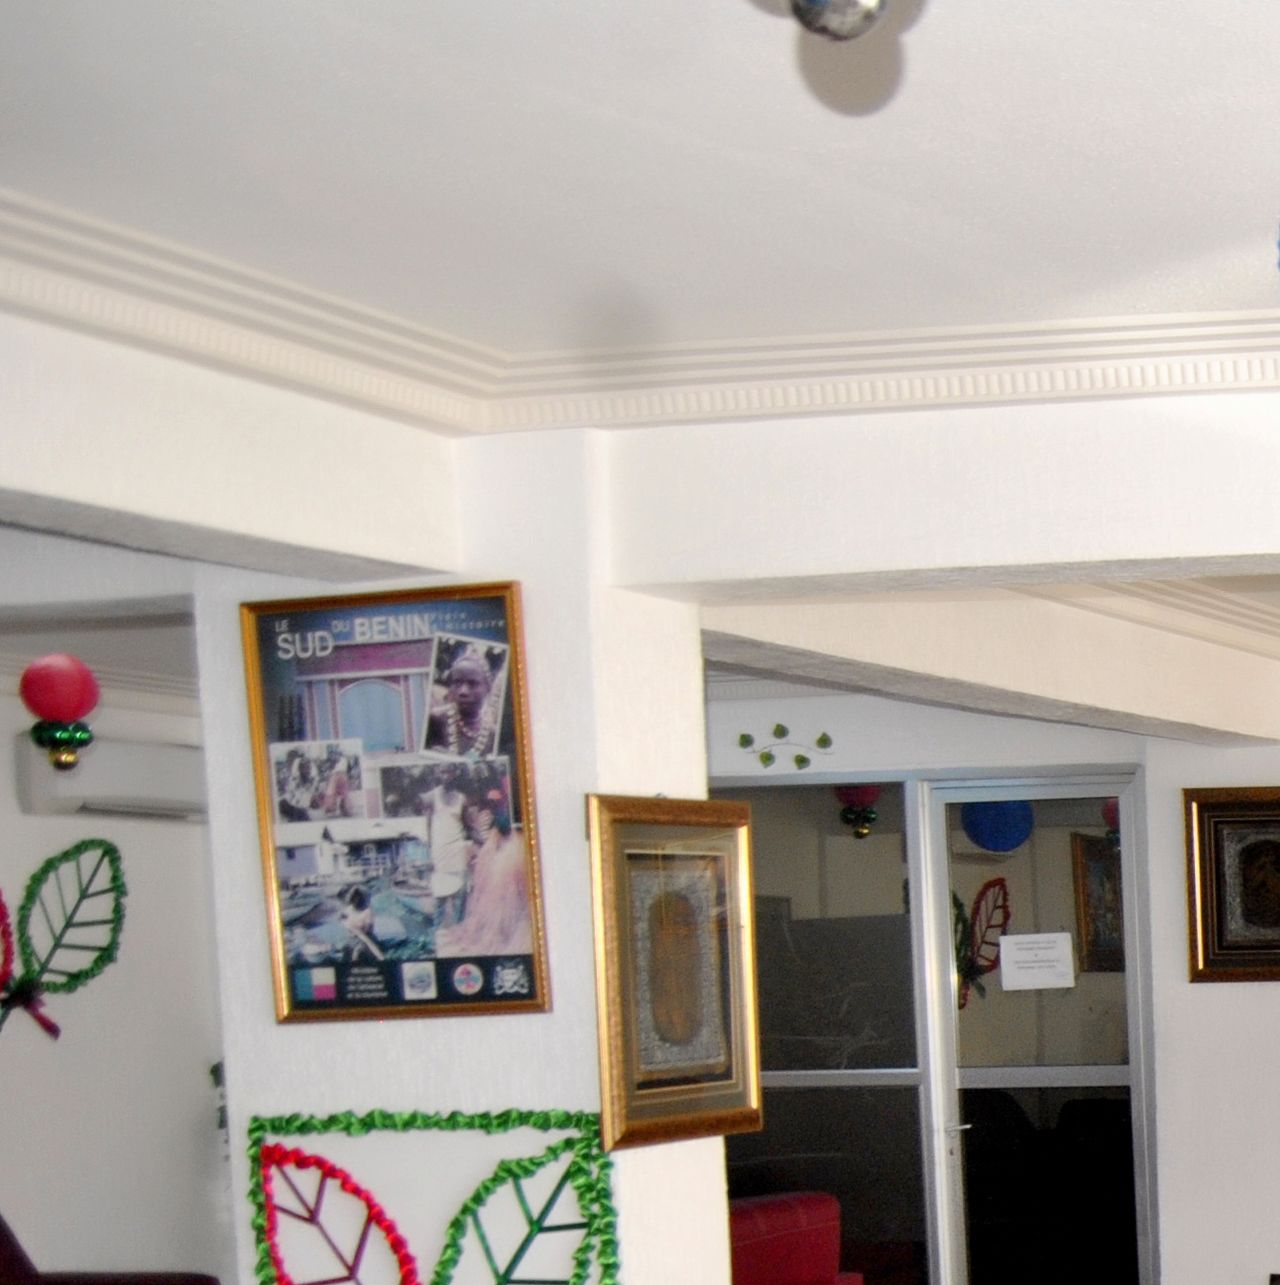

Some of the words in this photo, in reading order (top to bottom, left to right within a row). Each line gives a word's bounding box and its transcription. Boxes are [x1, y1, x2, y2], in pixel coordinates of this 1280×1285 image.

[275, 619, 289, 633] LE
[332, 619, 351, 633] DU
[354, 613, 431, 642] BENIN
[277, 629, 335, 660] SUD
